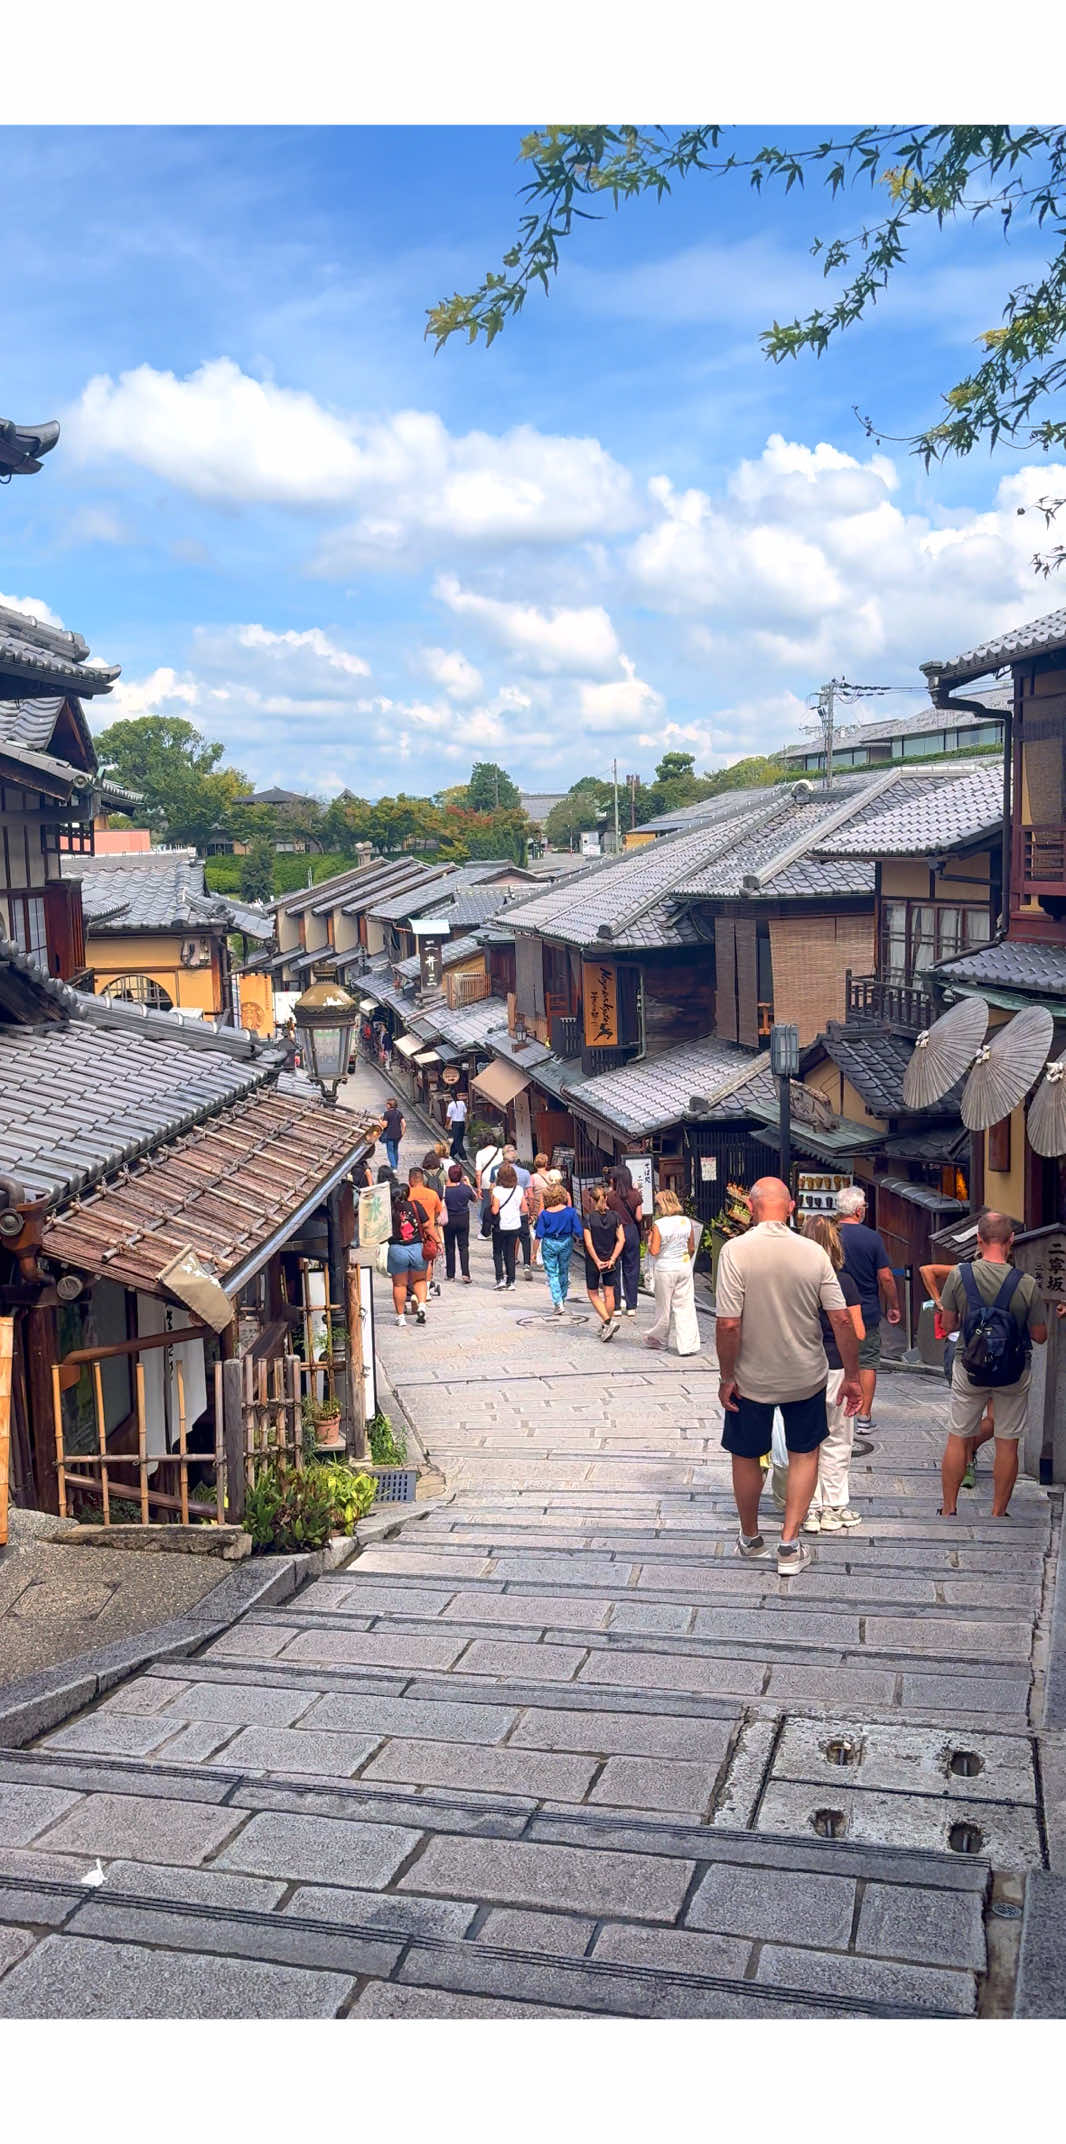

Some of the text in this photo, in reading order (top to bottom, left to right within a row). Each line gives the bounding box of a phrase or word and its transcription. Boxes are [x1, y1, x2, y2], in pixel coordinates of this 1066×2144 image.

[424, 939, 440, 986] 二井三
[1046, 1242, 1066, 1293] 二寧坂
